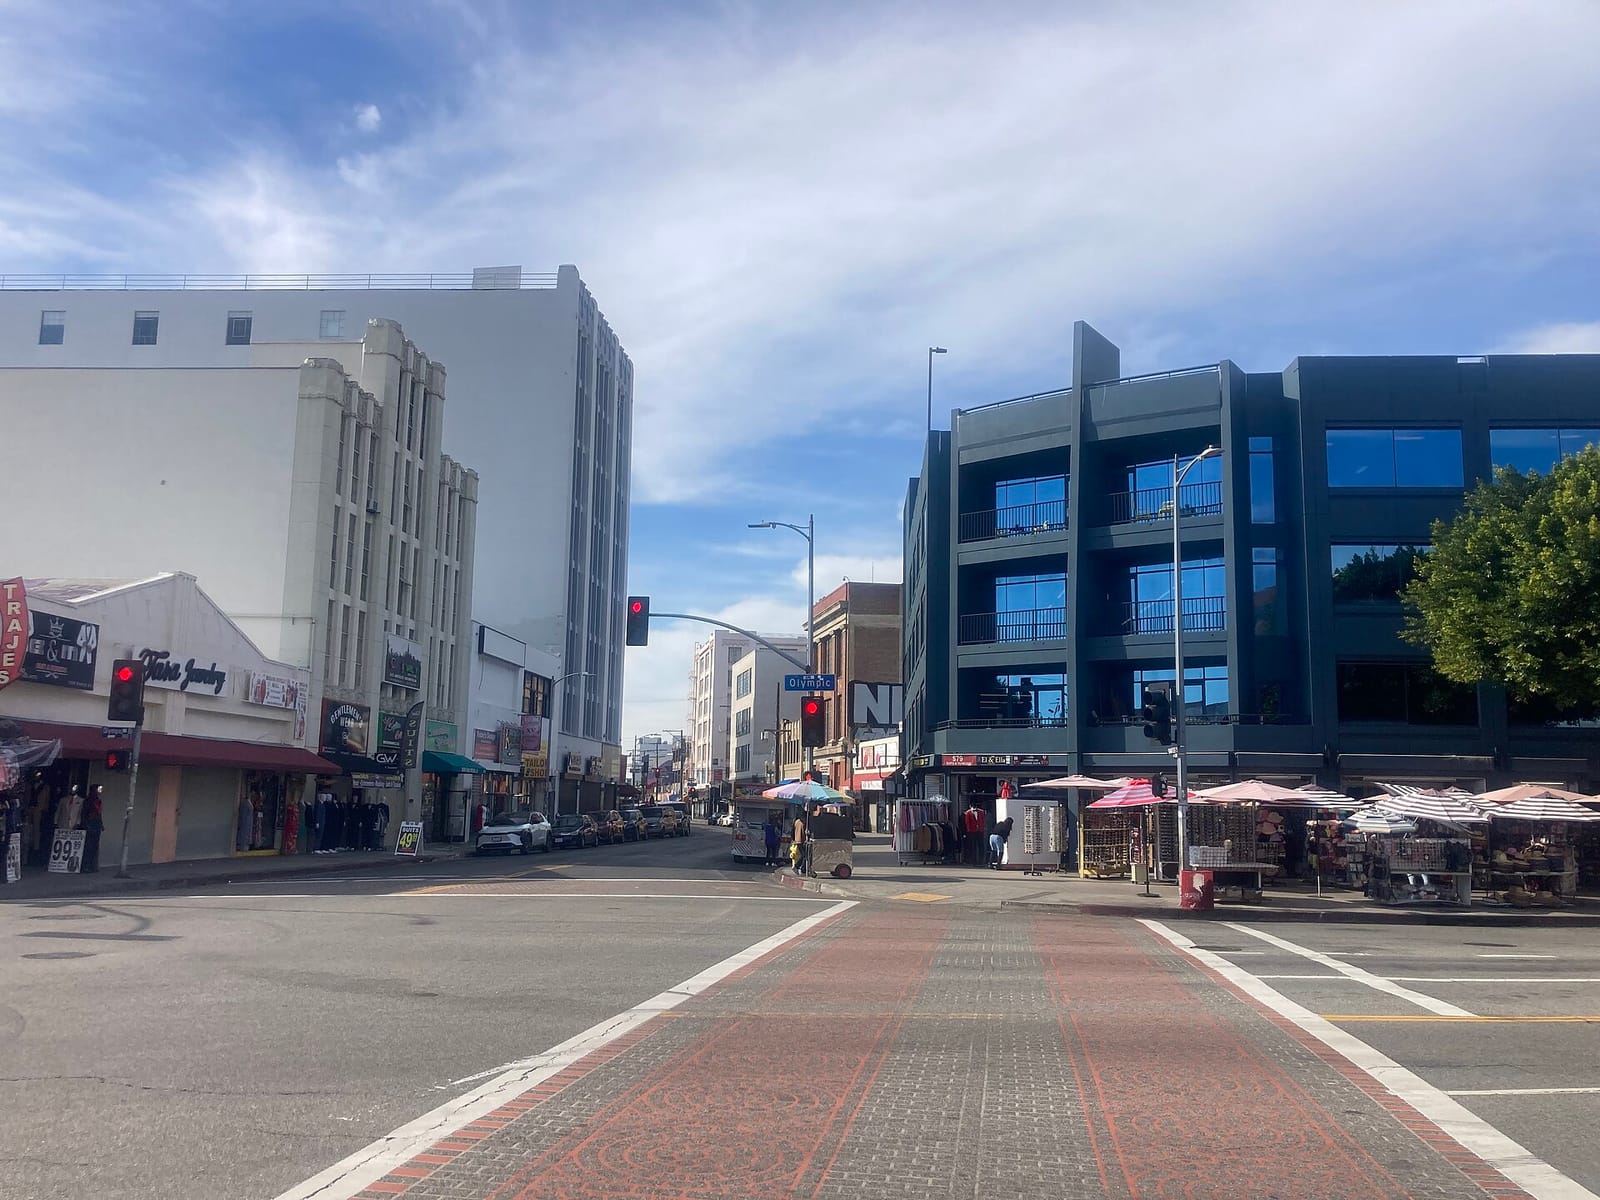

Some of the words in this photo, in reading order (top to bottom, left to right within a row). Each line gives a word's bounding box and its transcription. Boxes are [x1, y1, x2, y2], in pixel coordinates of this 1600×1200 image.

[0, 584, 22, 684] TRAJES
[47, 640, 60, 663] &
[789, 678, 831, 688] Olympic
[376, 753, 397, 763] GW
